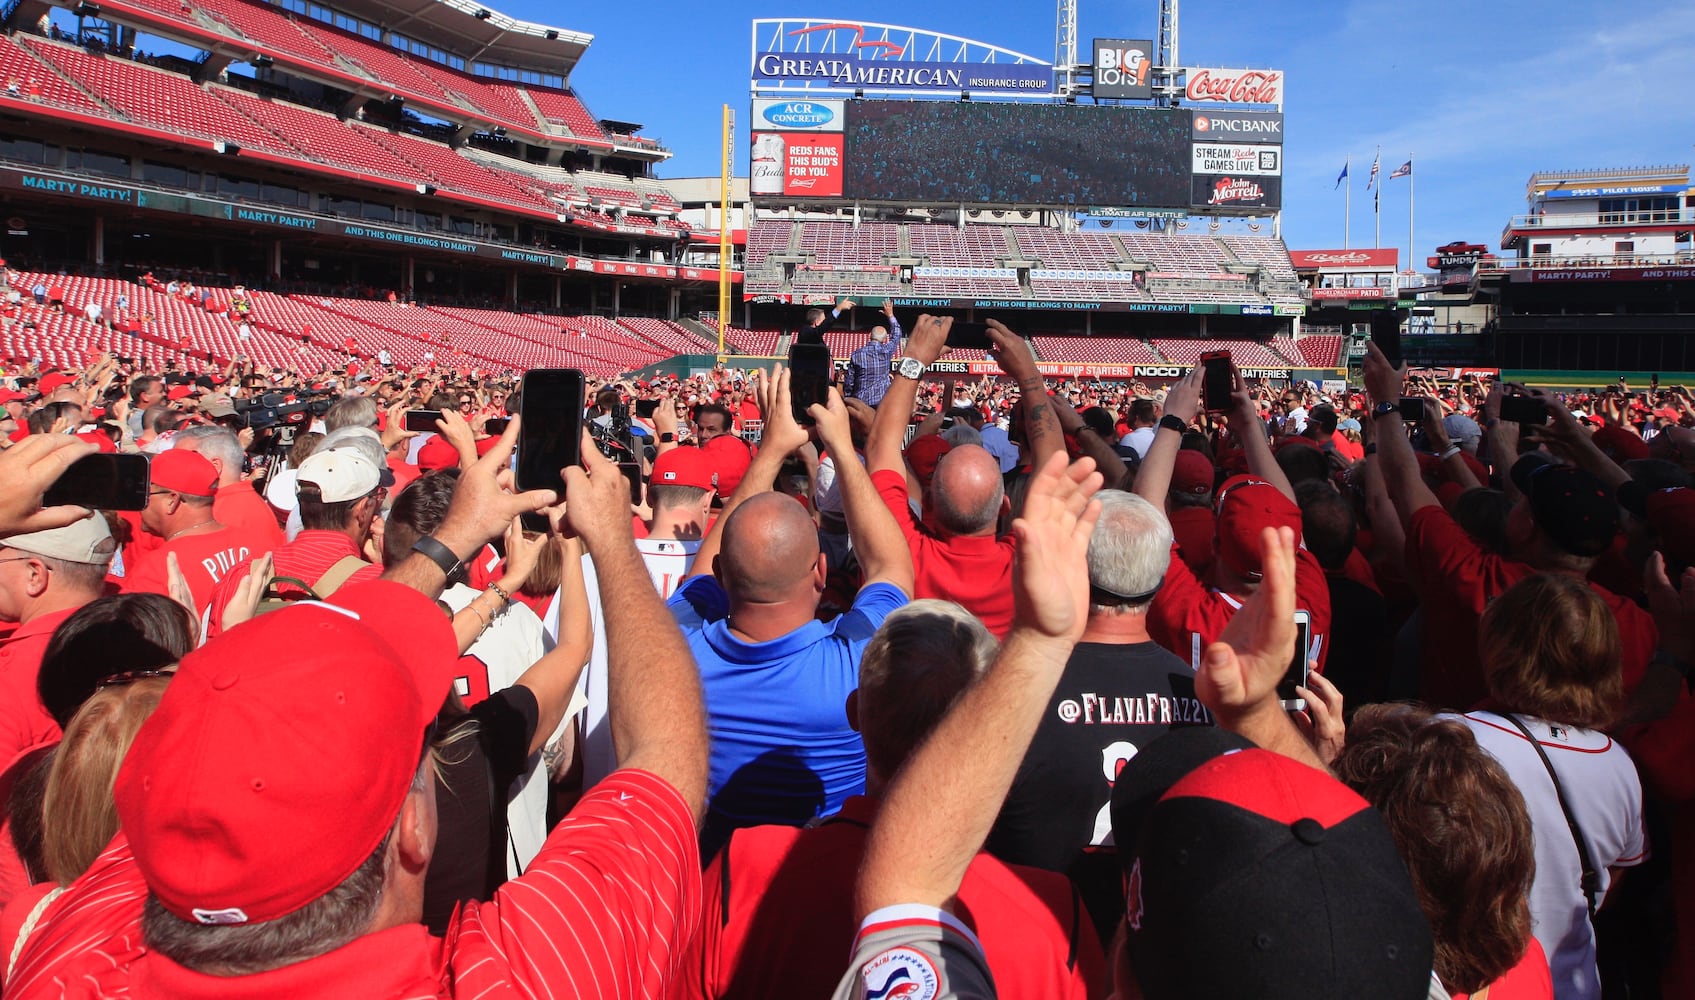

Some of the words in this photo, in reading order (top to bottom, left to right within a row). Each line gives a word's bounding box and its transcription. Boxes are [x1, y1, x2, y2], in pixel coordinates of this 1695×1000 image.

[1099, 48, 1145, 70] BIG
[759, 54, 843, 77] GREAT
[969, 78, 1016, 88] INSURANCE
[1018, 80, 1047, 88] GROUP
[1186, 70, 1281, 103] Coca-Cola
[784, 104, 812, 114] ACR
[772, 114, 823, 123] CONCRETE
[789, 146, 812, 155] REDS
[814, 146, 838, 156] FANS,
[1196, 148, 1231, 159] STREAM
[789, 156, 809, 166] THIS
[811, 157, 838, 166] BUD'S
[1204, 160, 1234, 171] GAMES
[1236, 161, 1255, 171] LIVE
[789, 167, 806, 176] FOR
[808, 167, 829, 176] YOU.
[1228, 178, 1250, 188] John
[22, 176, 76, 193] MARTY
[80, 185, 132, 202] PARTY!
[1208, 184, 1264, 204] Morrell
[238, 208, 276, 223] MARTY
[279, 215, 316, 229] PARTY!
[345, 226, 364, 236] AND
[365, 229, 385, 239] THIS
[386, 232, 403, 242] ONE
[404, 236, 438, 247] BELONGS
[440, 240, 450, 248] TO
[451, 242, 476, 252] MARTY
[502, 250, 524, 260] MARTY
[526, 254, 548, 264] PARTY!
[1304, 252, 1371, 262] Reds
[1440, 256, 1478, 264] TUNDRA
[1538, 272, 1572, 280] MARTY
[1574, 270, 1611, 279] PARTY!
[1642, 270, 1664, 278] AND
[1666, 270, 1689, 278] THIS
[1158, 304, 1186, 312] PARTY!
[973, 362, 998, 372] ULTRA
[1060, 366, 1084, 374] JUMP
[1086, 366, 1130, 376] STARTERS.
[1134, 367, 1180, 376] NOCO
